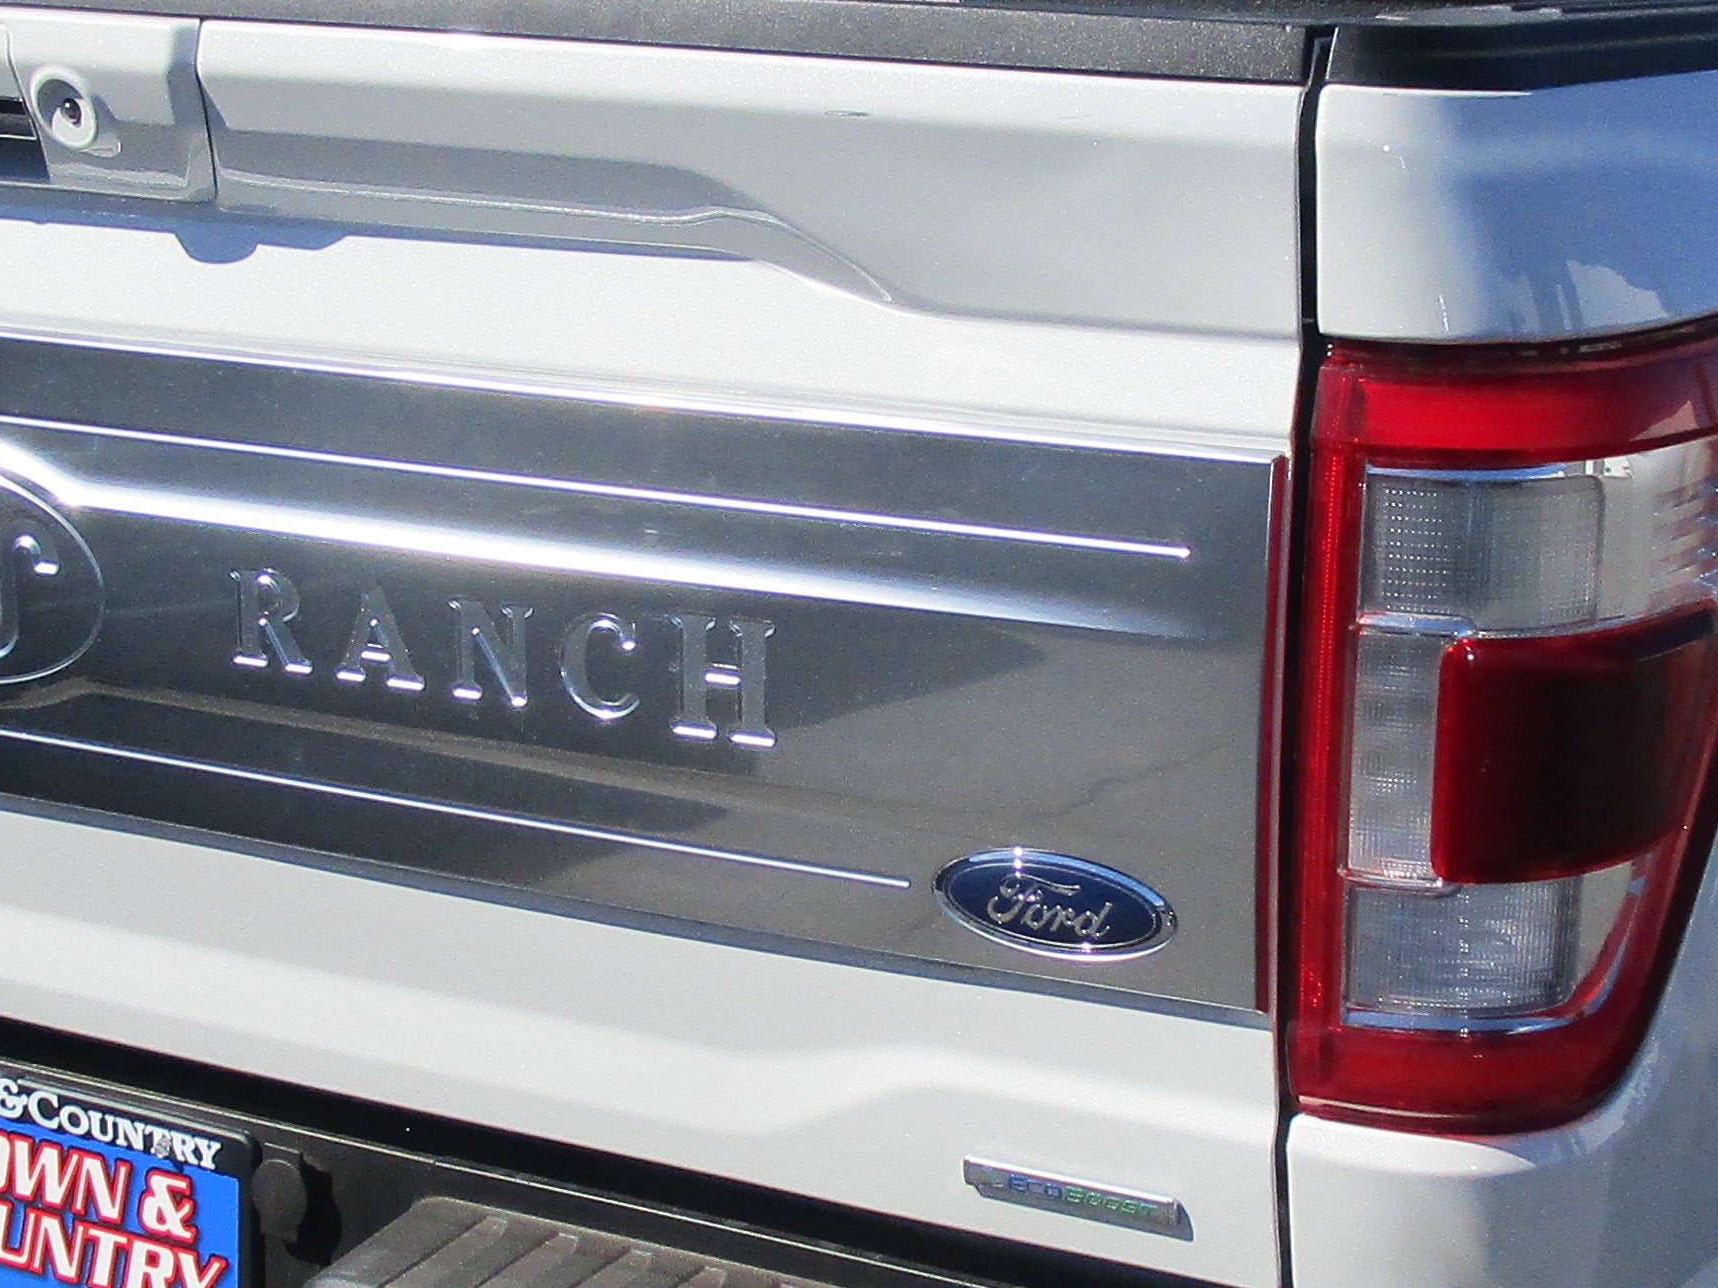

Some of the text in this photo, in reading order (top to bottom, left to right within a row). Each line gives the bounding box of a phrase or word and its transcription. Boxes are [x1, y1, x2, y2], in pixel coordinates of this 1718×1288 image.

[230, 567, 775, 749] RANCH
[986, 872, 1112, 939] Ford
[139, 1169, 197, 1243] &
